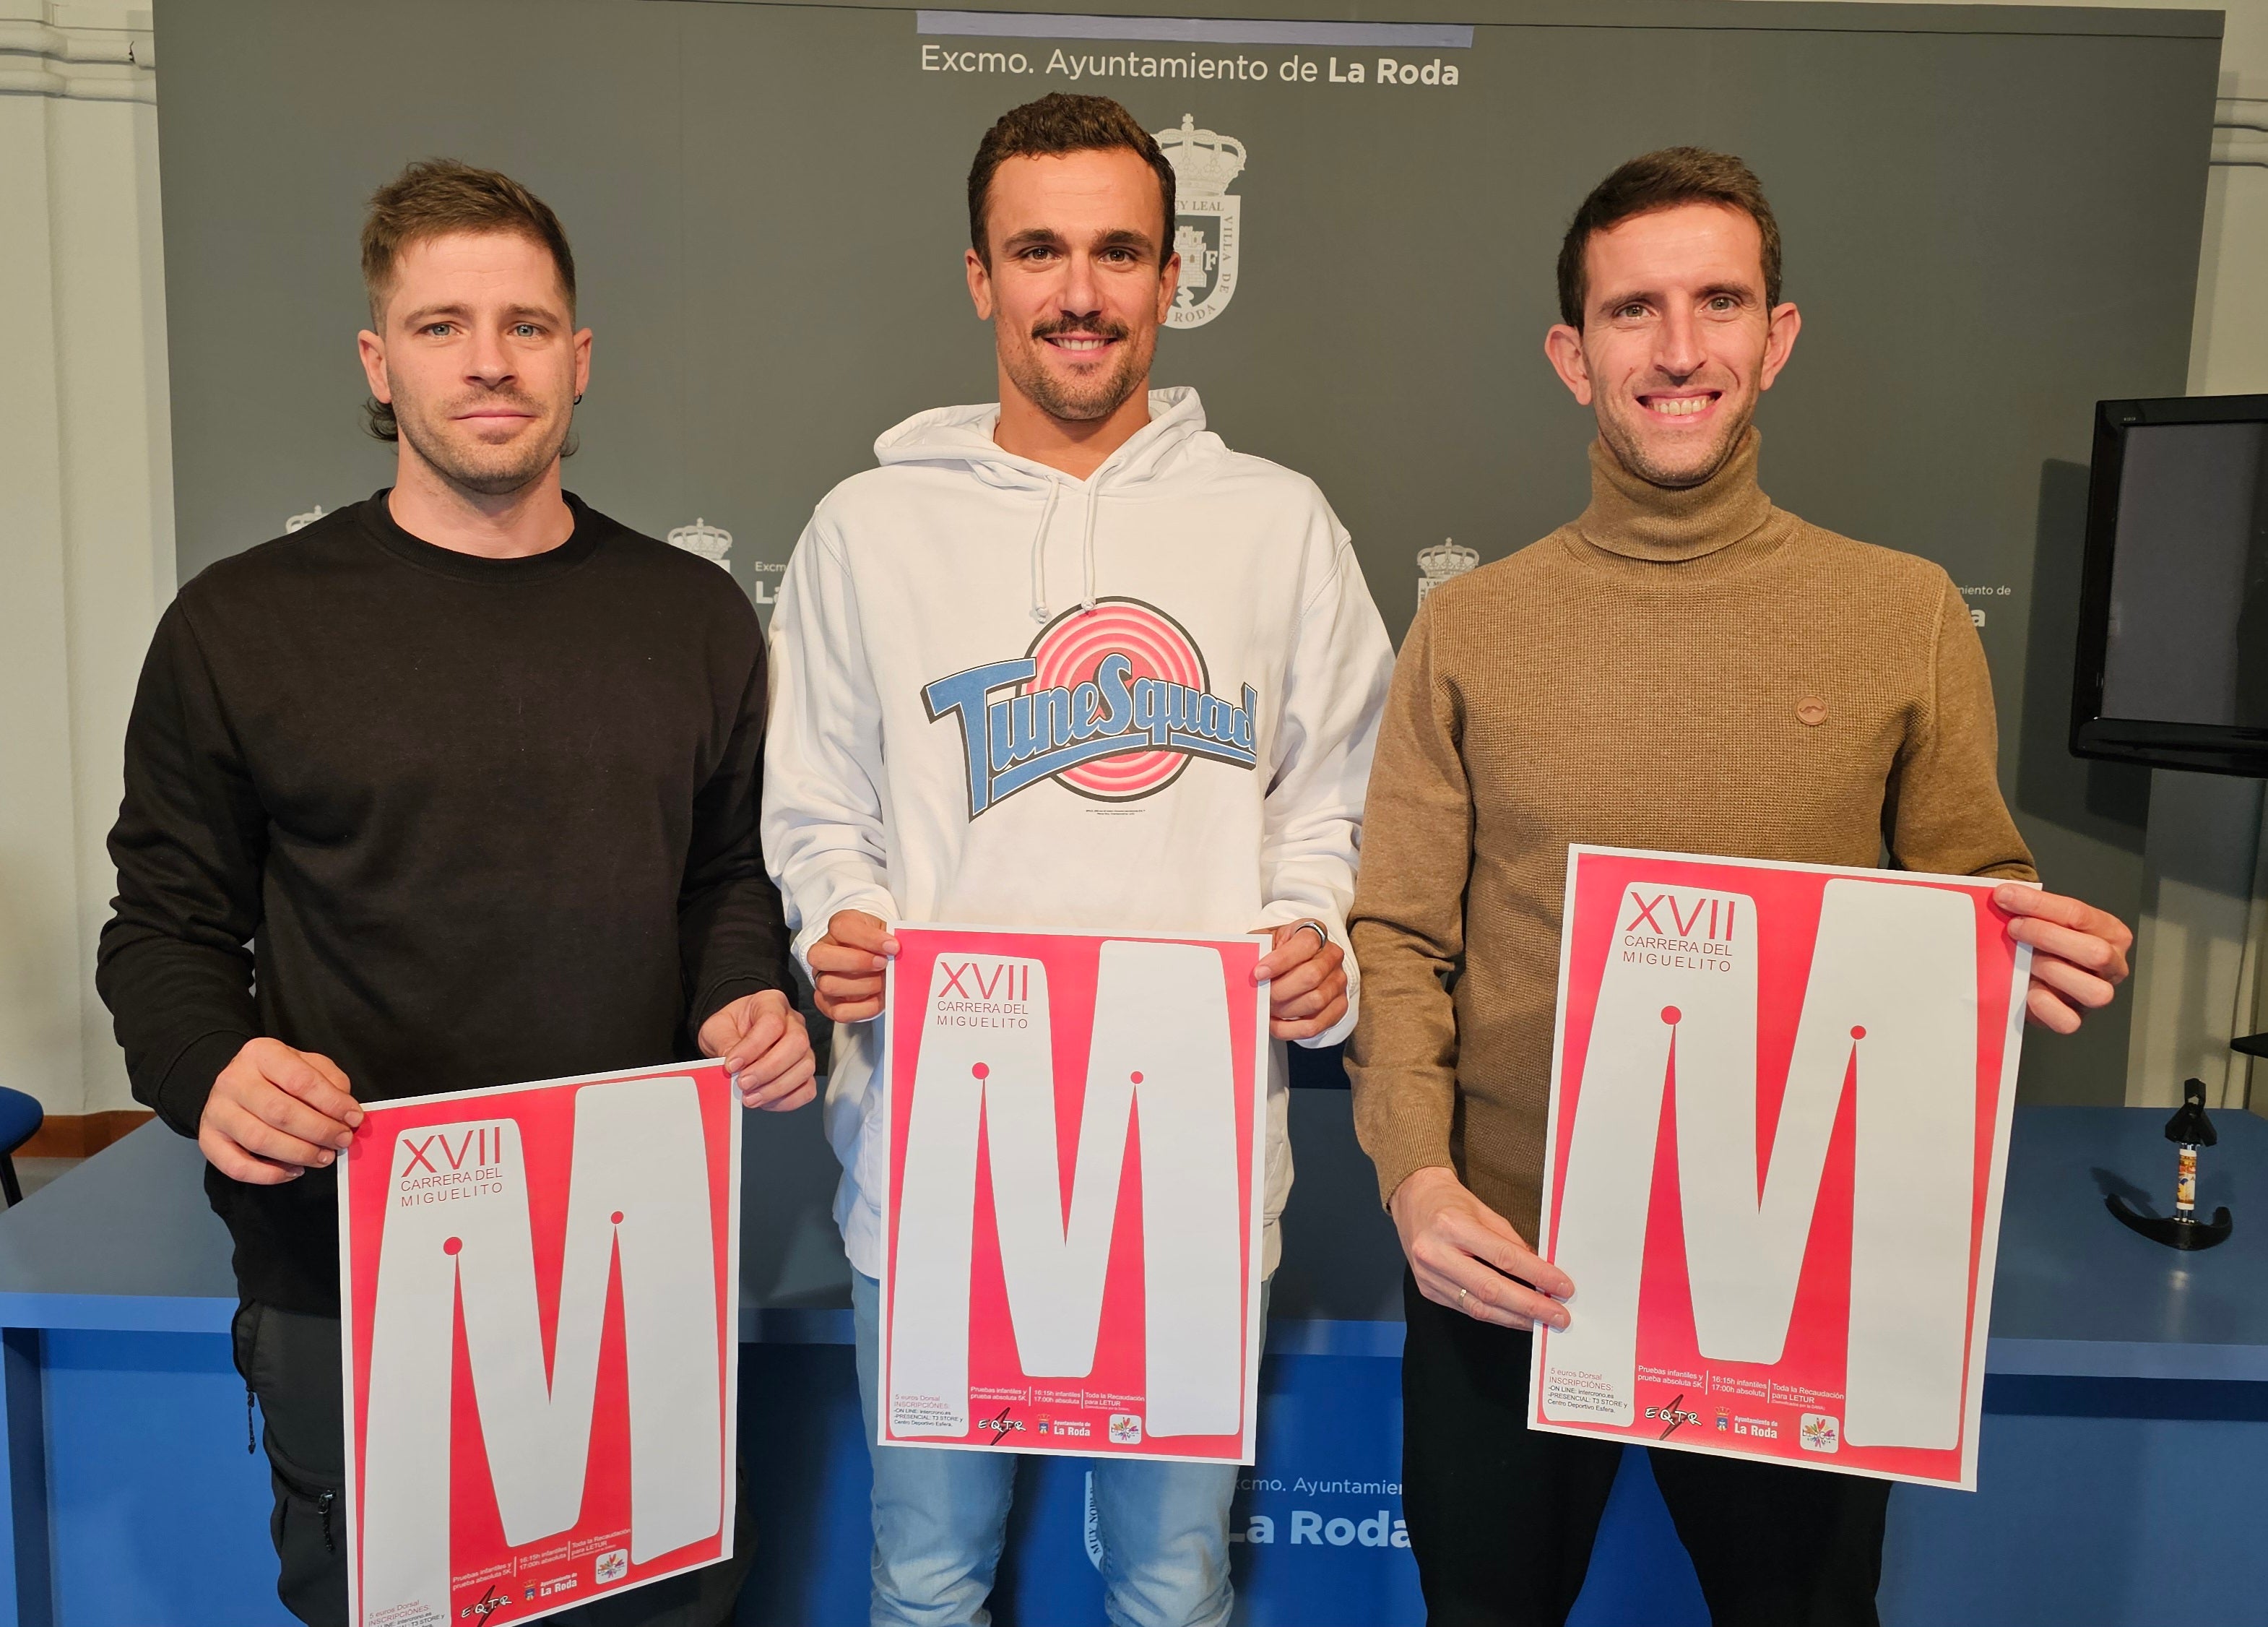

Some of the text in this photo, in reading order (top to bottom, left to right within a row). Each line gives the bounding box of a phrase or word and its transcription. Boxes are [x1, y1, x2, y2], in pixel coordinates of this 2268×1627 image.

[922, 44, 1460, 85] Excmo. Ayuntamiento de La Roda
[1193, 201, 1224, 212] LEAL
[1222, 216, 1233, 262] VILLA
[1174, 303, 1216, 323] RODA
[755, 561, 787, 572] Excm
[1996, 584, 2011, 596] de
[1625, 892, 1736, 941] XVII
[1624, 935, 1733, 957] CARRERA DEL
[1623, 951, 1731, 972] MIGUELITO
[938, 962, 1029, 1001] XVII
[938, 1001, 1029, 1015] CARRERA DEL
[937, 1015, 1028, 1029] MIGUELITO
[401, 1126, 501, 1178] XVII
[401, 1167, 503, 1191] CARRERA DEL
[401, 1182, 503, 1207] MIGUELITO
[1579, 1371, 1602, 1380] Dorsal
[1638, 1365, 1666, 1375] Pruebas
[1667, 1369, 1697, 1379] infantiles
[1662, 1377, 1692, 1386] absoluta
[1712, 1376, 1767, 1389] 16:15h infantiles
[1107, 1393, 1146, 1402] Recaudación
[1712, 1384, 1765, 1397] 17:00h absoluta
[1772, 1383, 1789, 1392] Toda
[1799, 1386, 1845, 1400] Recaudación
[1547, 1398, 1567, 1407] Centro
[1567, 1401, 1595, 1410] Deportivo
[1601, 1399, 1623, 1407] STORE
[1789, 1394, 1815, 1404] LETUR
[1734, 1415, 1770, 1426] Ayuntamiento
[1054, 1425, 1091, 1436] La Roda
[1734, 1423, 1778, 1439] La Roda
[1293, 1477, 1403, 1496] Ayuntamie
[1290, 1510, 1412, 1548] Roda
[586, 1540, 607, 1551] LETUR
[540, 1579, 577, 1597] La Roda
[397, 1599, 420, 1611] Dorsal
